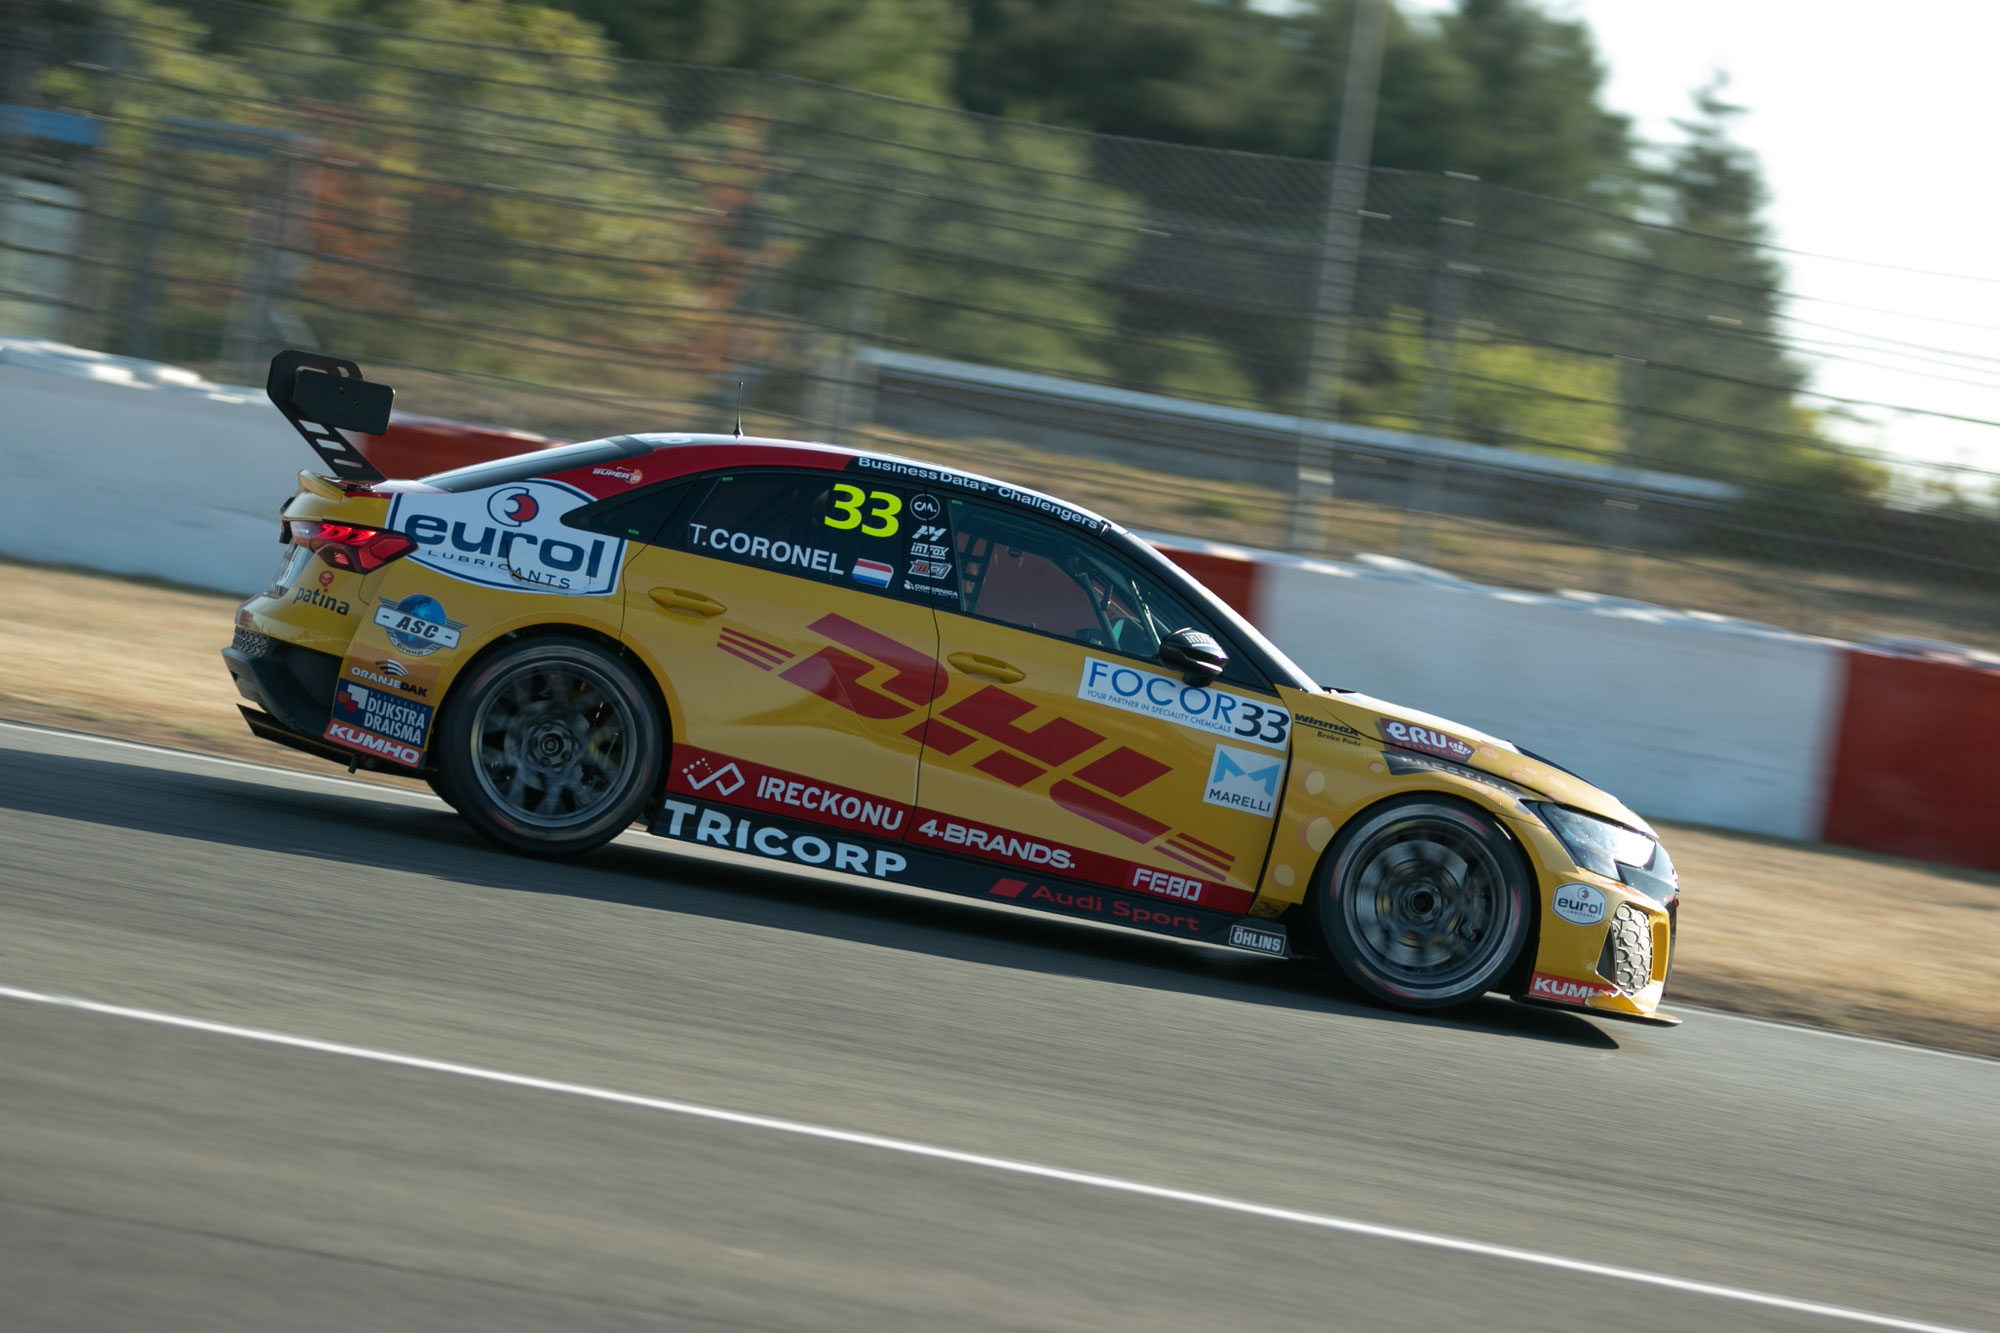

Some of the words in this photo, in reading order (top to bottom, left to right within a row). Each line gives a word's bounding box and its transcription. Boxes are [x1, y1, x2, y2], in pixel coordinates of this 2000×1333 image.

[824, 483, 903, 538] 33
[858, 456, 938, 480] Business
[940, 471, 980, 490] Data
[998, 487, 1098, 530] Challengers
[404, 513, 605, 579] eurol
[427, 549, 571, 590] LUBRICANTS
[292, 587, 351, 616] patina
[395, 615, 440, 639] ASC
[350, 666, 429, 698] ORANJEDAK
[1088, 660, 1238, 725] FOCOR
[1234, 701, 1290, 744] 33
[363, 713, 422, 745] DRAISMA
[367, 697, 426, 730] DIJKSTRA
[778, 612, 1174, 845] DHL
[1086, 689, 1108, 700] YOUR
[1108, 694, 1140, 708] PARTNER
[1141, 702, 1150, 711] IN
[1151, 705, 1190, 721] SPECIALITY
[1190, 716, 1232, 733] CHEMICALS
[1294, 713, 1359, 736] Winmax
[329, 723, 419, 764] KUMHO
[1317, 730, 1340, 741] Brake
[1342, 737, 1361, 747] Pads
[756, 775, 904, 831] IRECKONU
[1208, 788, 1272, 813] MARELLI
[664, 799, 908, 878] TRICORP
[918, 819, 1076, 870] 4.BRANDS.
[1031, 885, 1102, 912] Audi
[1112, 900, 1200, 932] Sport
[1557, 897, 1603, 916] eurol
[1232, 927, 1283, 952] ÖHLINS
[1534, 976, 1606, 999] KUMH
